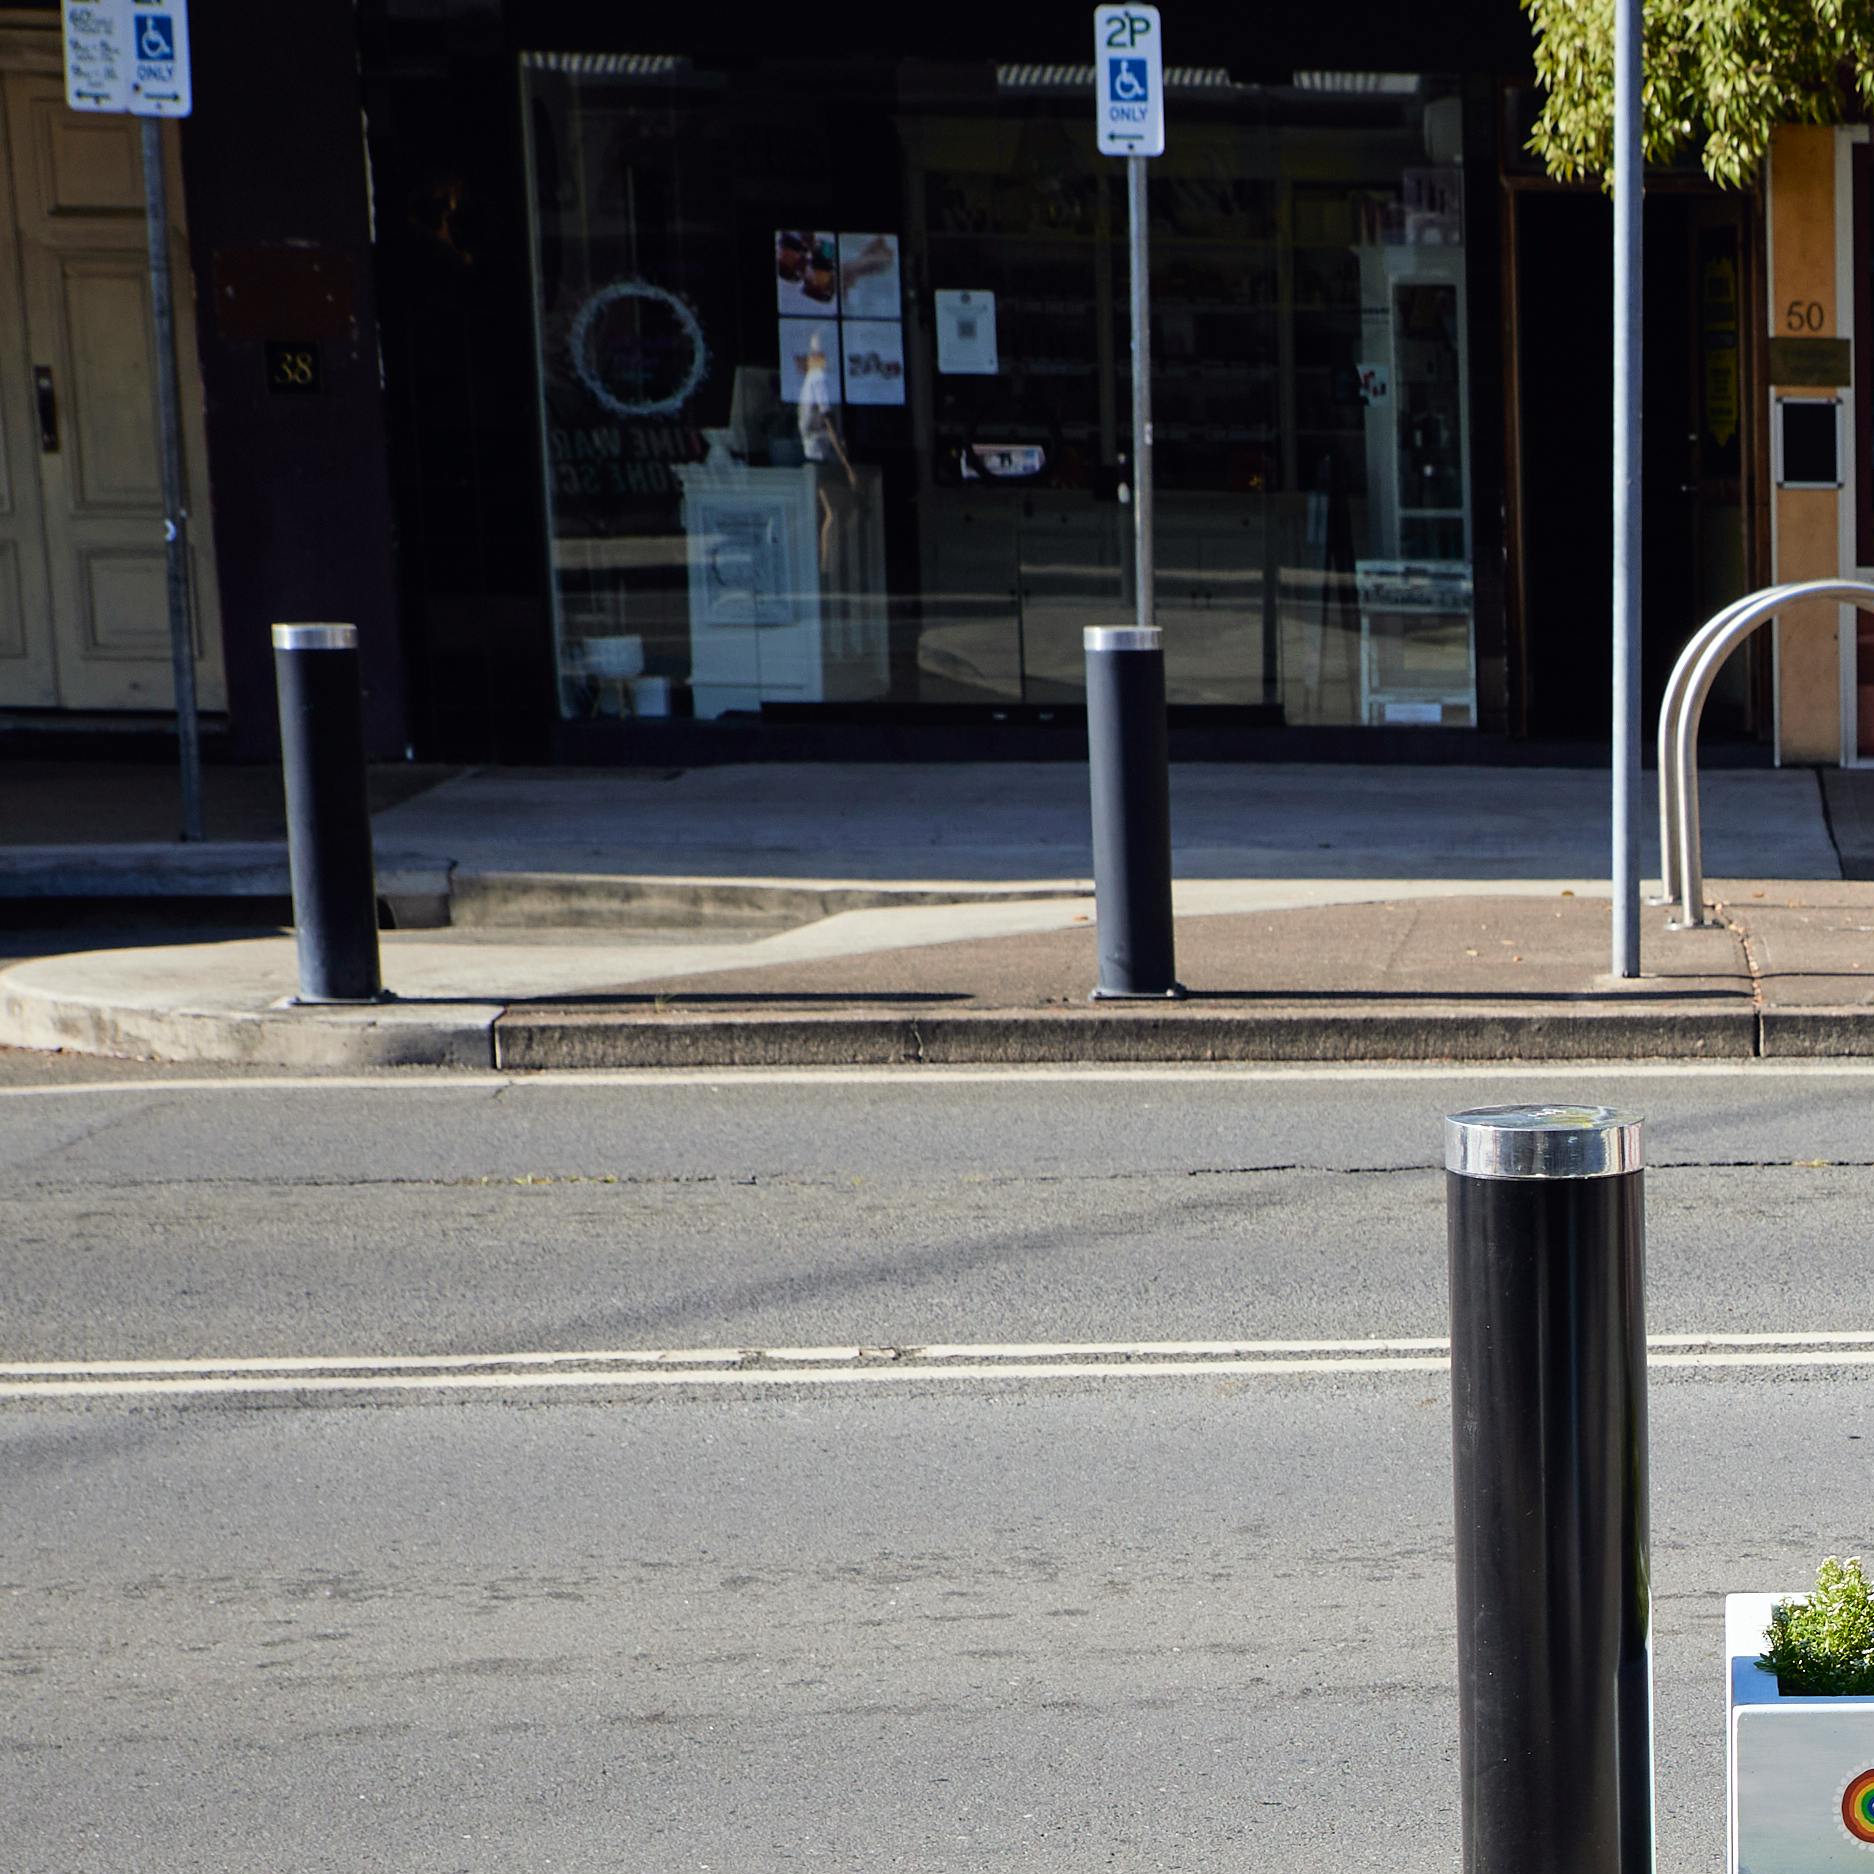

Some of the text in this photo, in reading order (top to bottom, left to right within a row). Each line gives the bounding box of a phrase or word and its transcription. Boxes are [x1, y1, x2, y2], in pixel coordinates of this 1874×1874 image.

[1106, 16, 1150, 48] 2P
[137, 65, 174, 81] ONLY
[1109, 107, 1147, 122] ONLY
[1786, 302, 1824, 332] 50
[274, 351, 313, 385] 38
